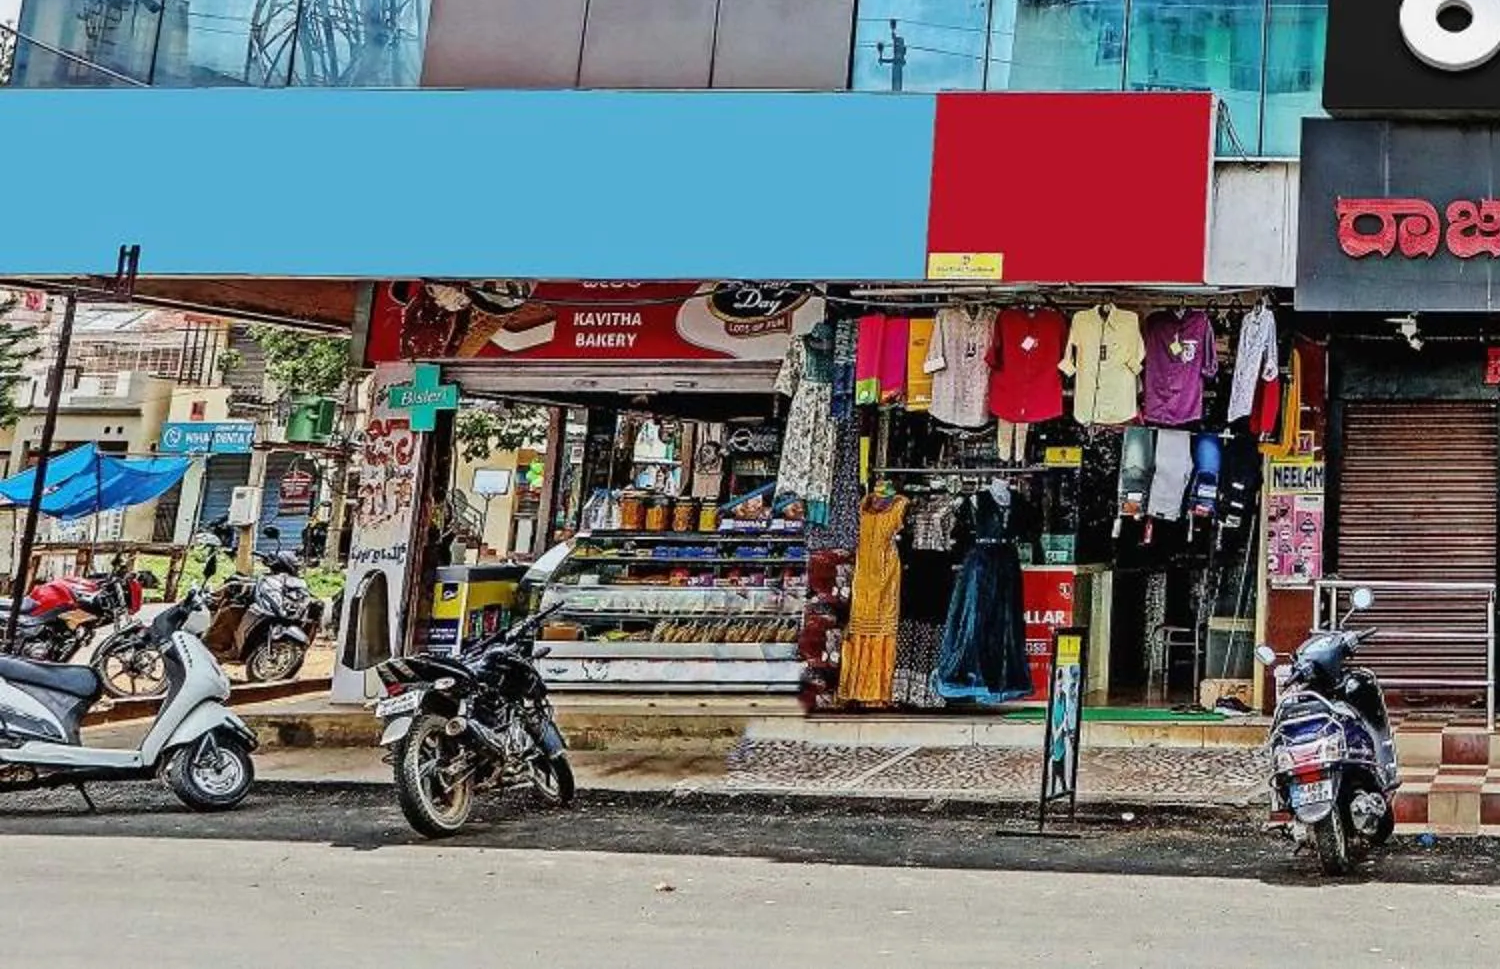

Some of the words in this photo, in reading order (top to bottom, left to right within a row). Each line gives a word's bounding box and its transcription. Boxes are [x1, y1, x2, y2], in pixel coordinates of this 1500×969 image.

[732, 286, 783, 317] Day
[573, 312, 643, 327] KAVITHA
[575, 334, 638, 348] BAKERY
[1273, 466, 1324, 489] NEELAM
[1024, 610, 1066, 625] LLAR
